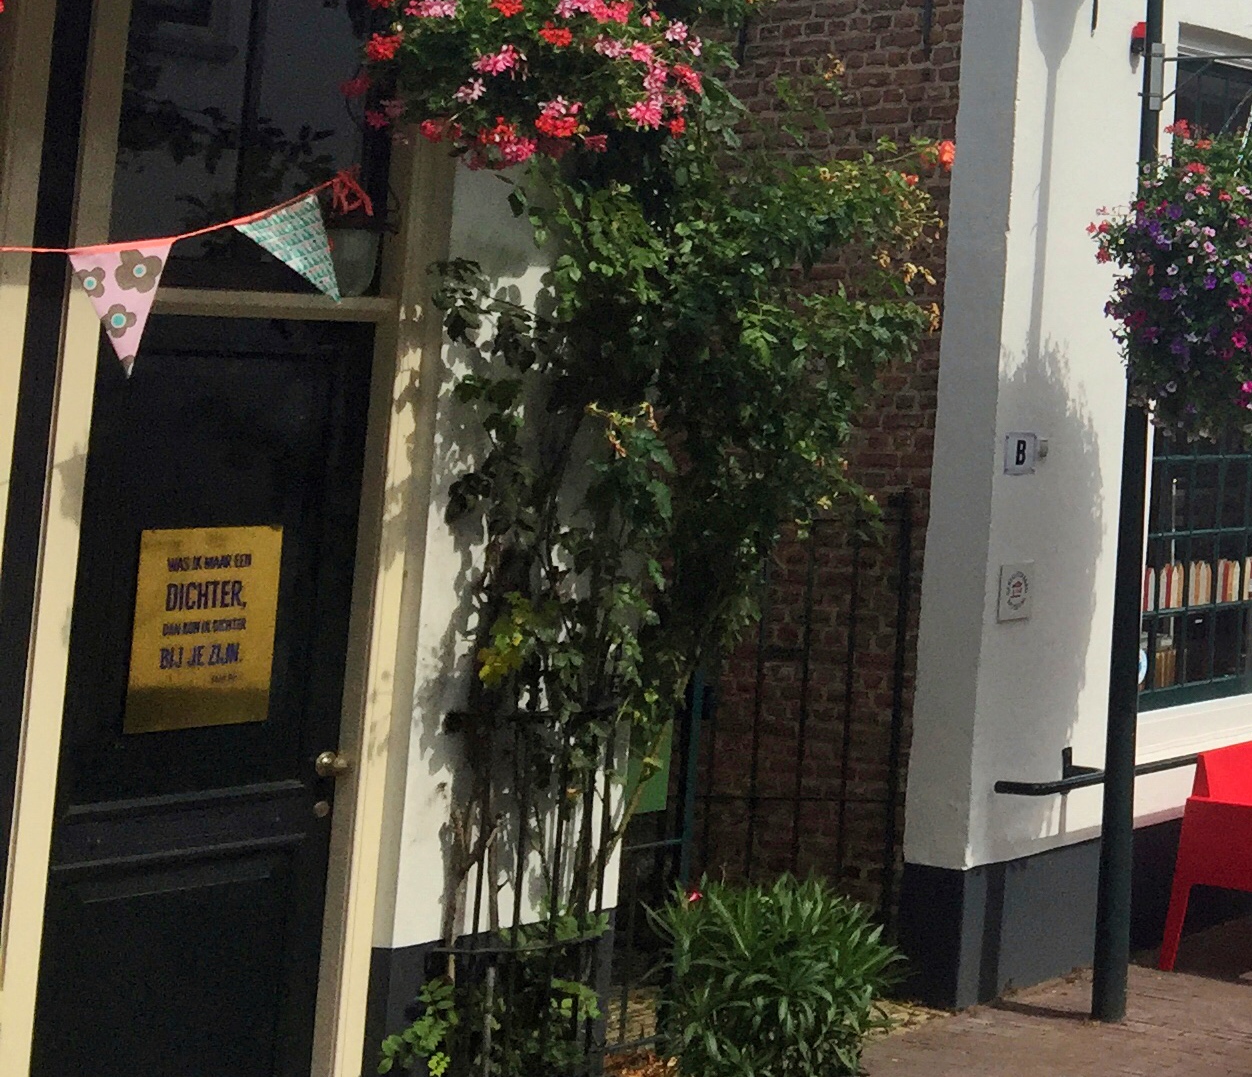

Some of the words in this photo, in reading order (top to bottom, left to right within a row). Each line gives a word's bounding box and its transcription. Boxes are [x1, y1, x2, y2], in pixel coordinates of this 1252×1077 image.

[1015, 439, 1027, 466] B
[234, 553, 252, 568] EEN
[165, 580, 248, 612] DICHTER,
[158, 646, 184, 669] BIJ
[187, 645, 206, 666] JE
